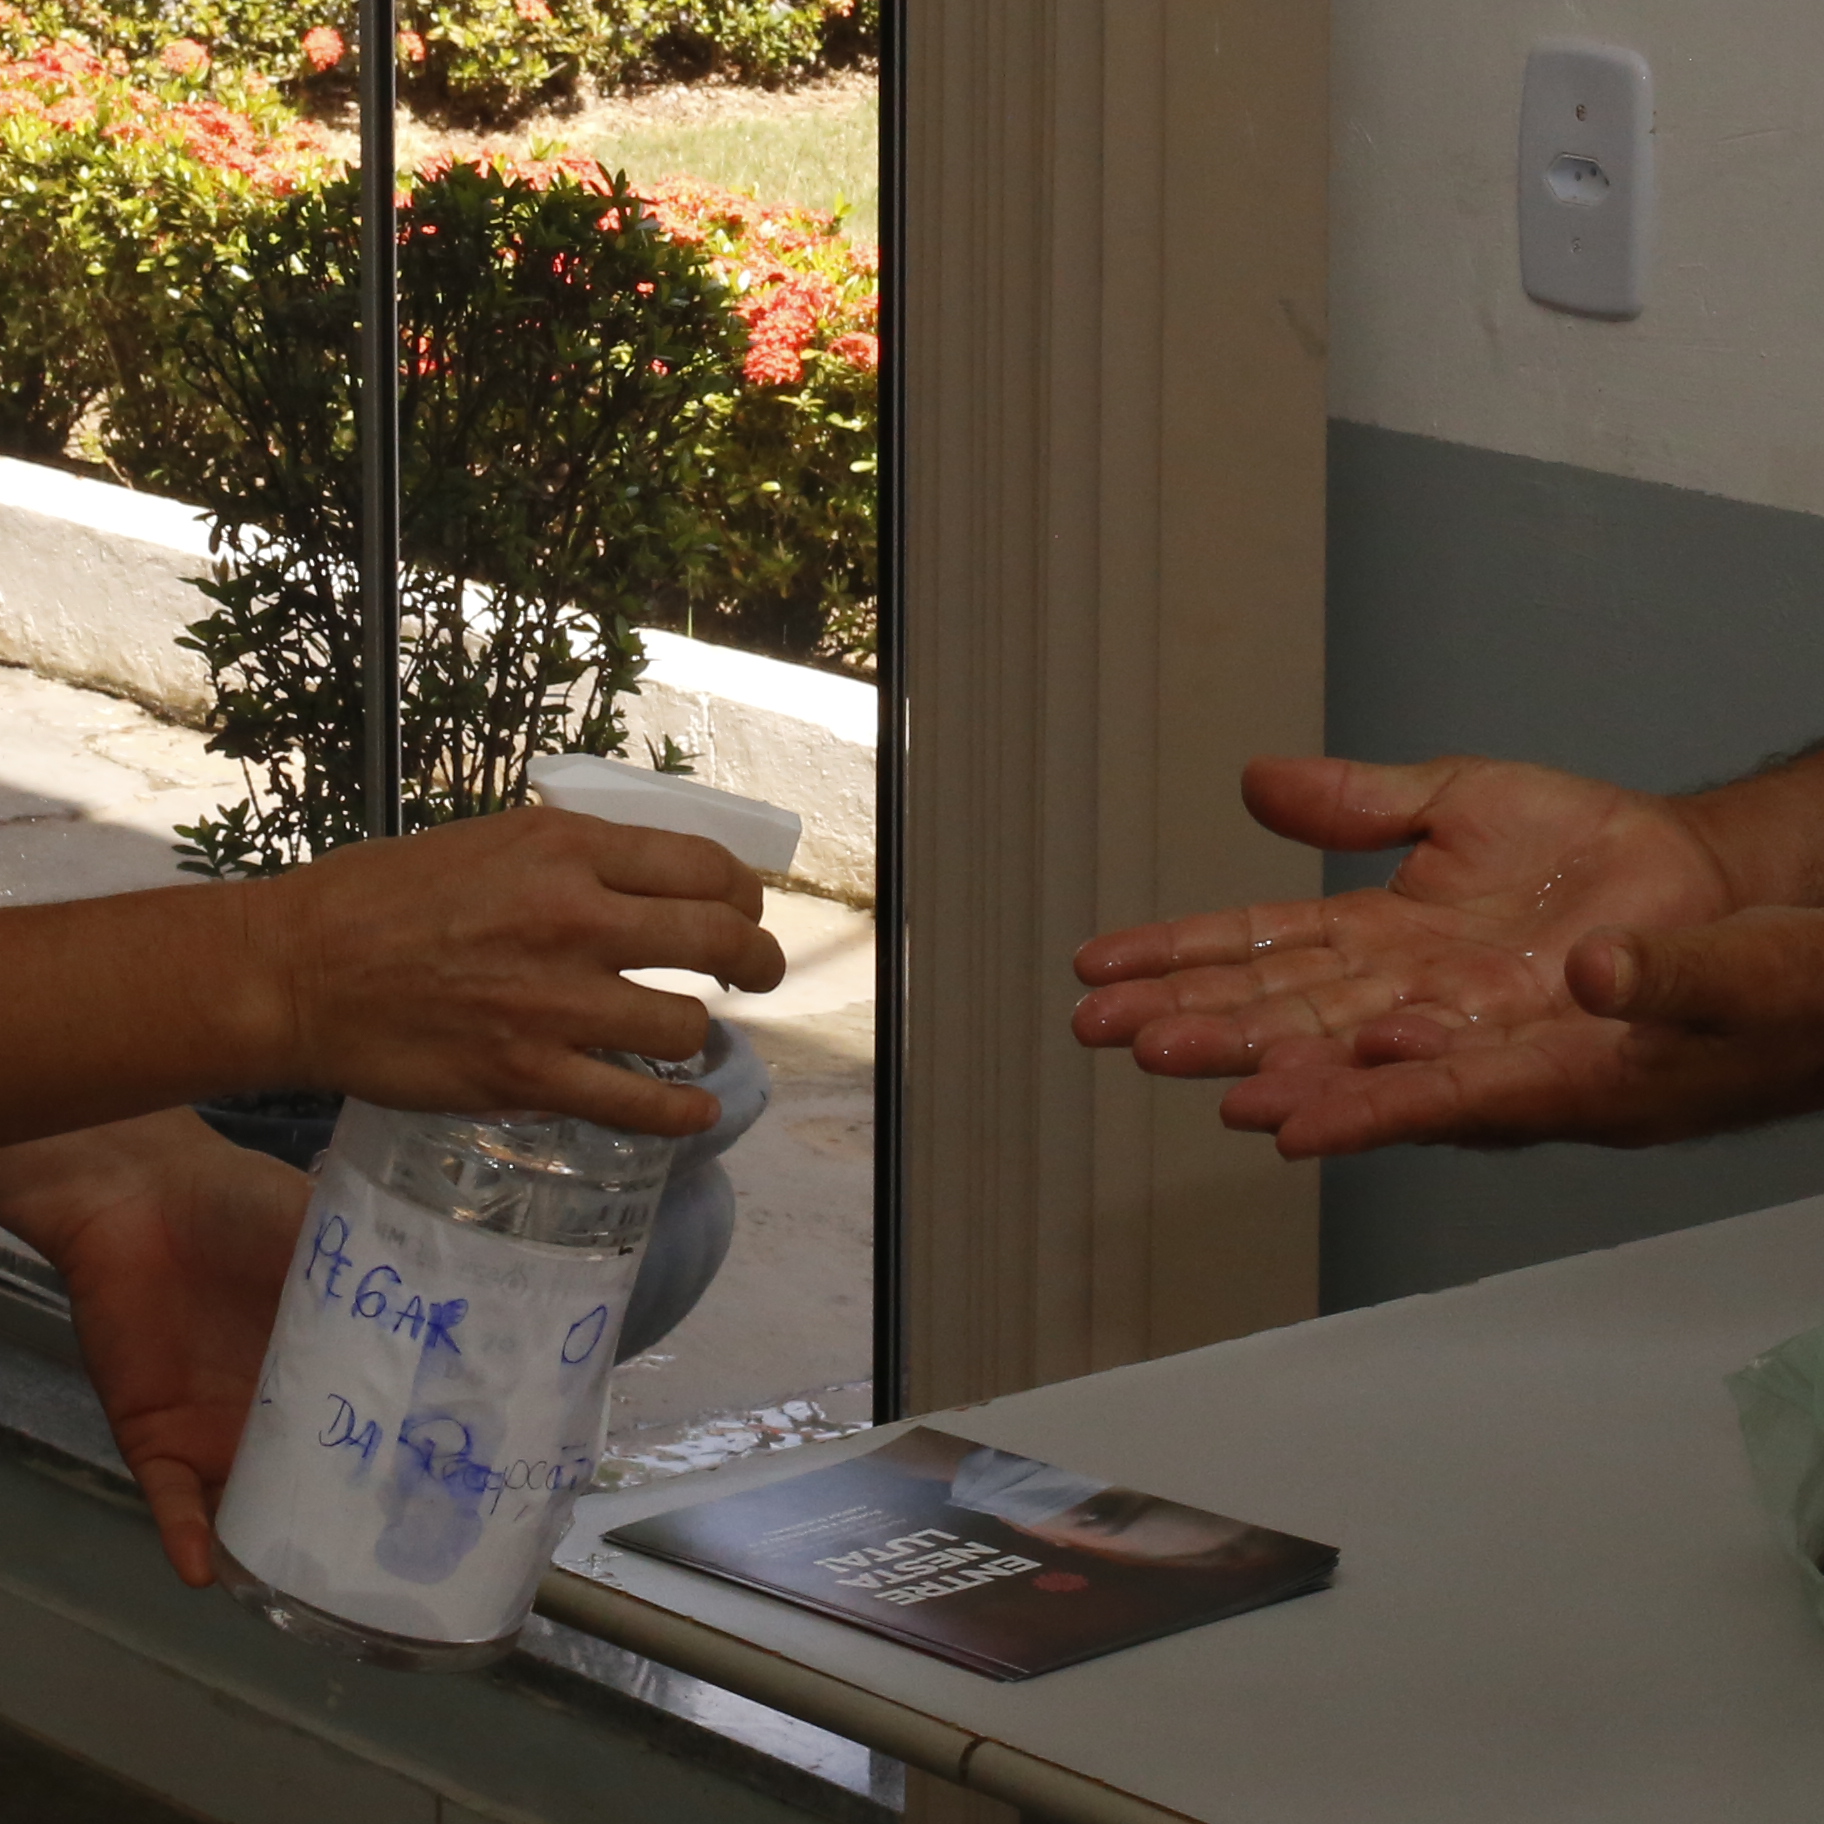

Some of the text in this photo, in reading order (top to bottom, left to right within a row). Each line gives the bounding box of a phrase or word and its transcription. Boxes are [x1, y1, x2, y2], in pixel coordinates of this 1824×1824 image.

[305, 1214, 469, 1355] PEGAR
[317, 1392, 383, 1459] DA
[812, 1527, 960, 1575] LUTA!
[833, 1541, 1001, 1590] NESTA
[874, 1555, 1043, 1606] ENTRE
